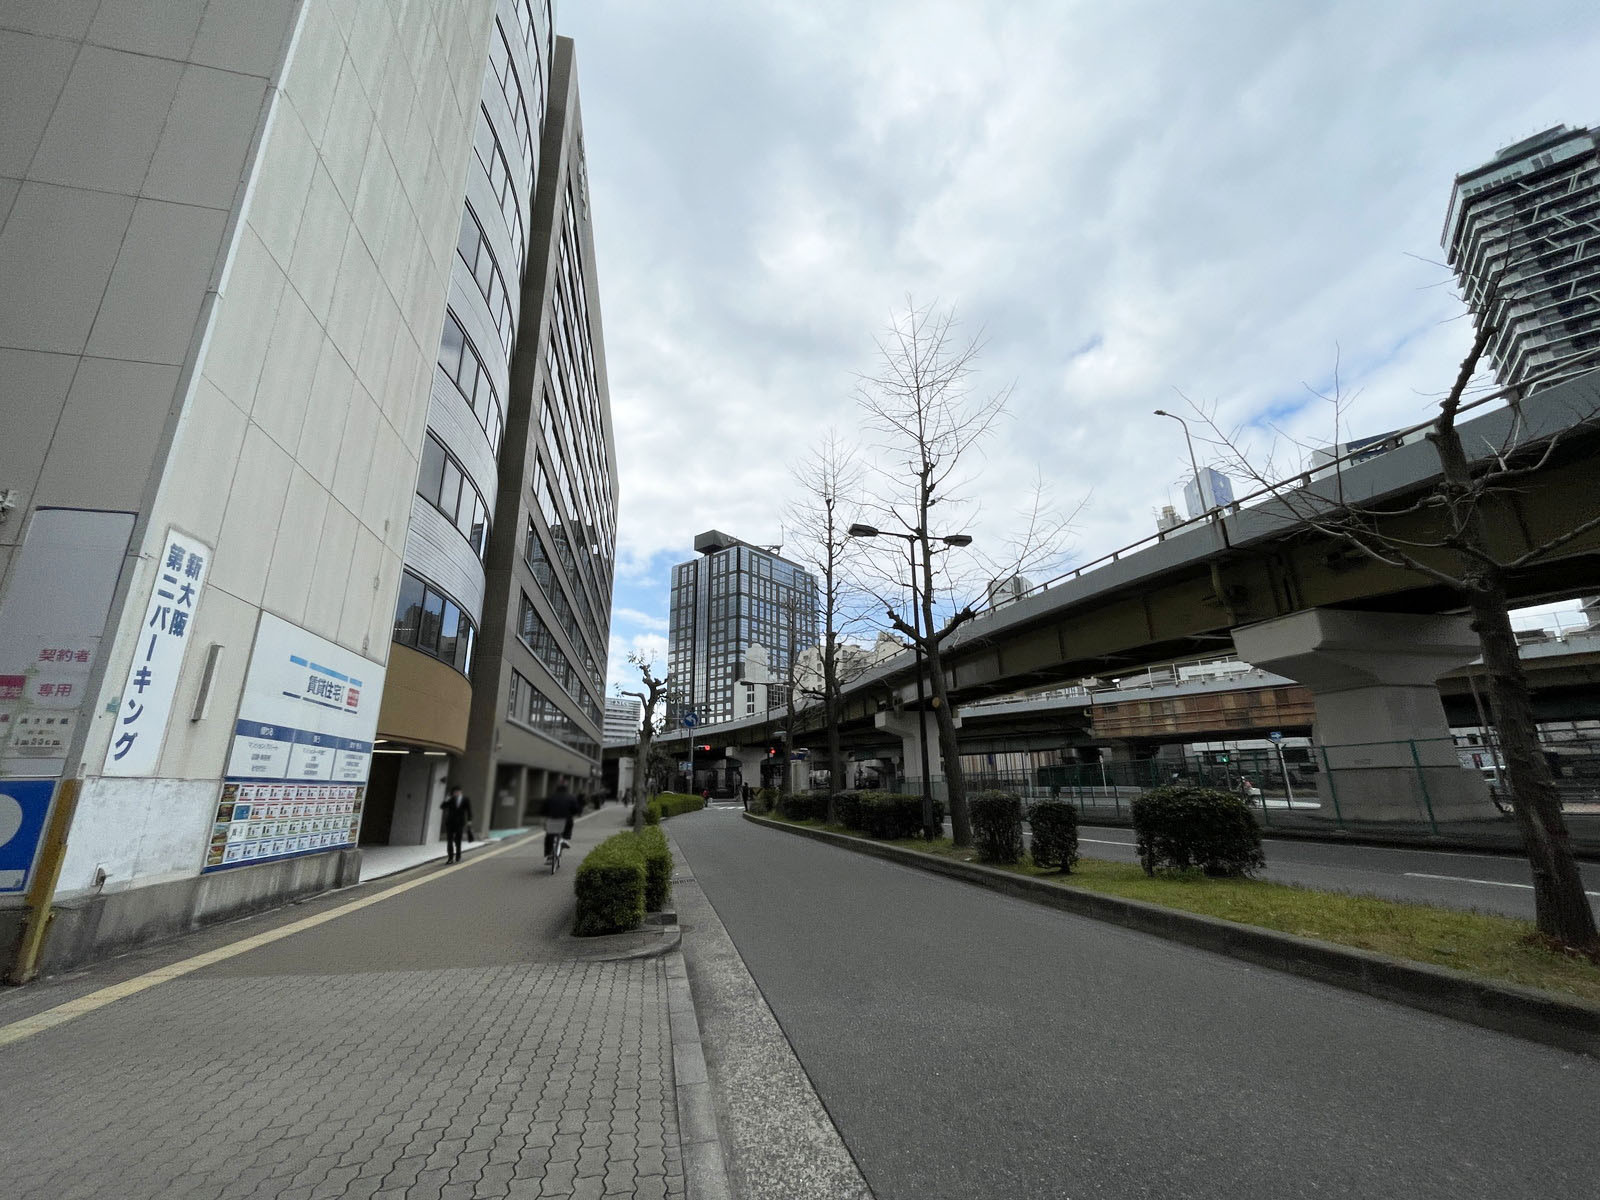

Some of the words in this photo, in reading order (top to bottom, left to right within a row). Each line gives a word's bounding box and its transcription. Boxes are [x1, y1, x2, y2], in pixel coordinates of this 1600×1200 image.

[168, 552, 204, 638] 新大阪
[39, 649, 90, 662] 契約者
[114, 543, 187, 761] 第二パーキング
[38, 683, 73, 697] 専用
